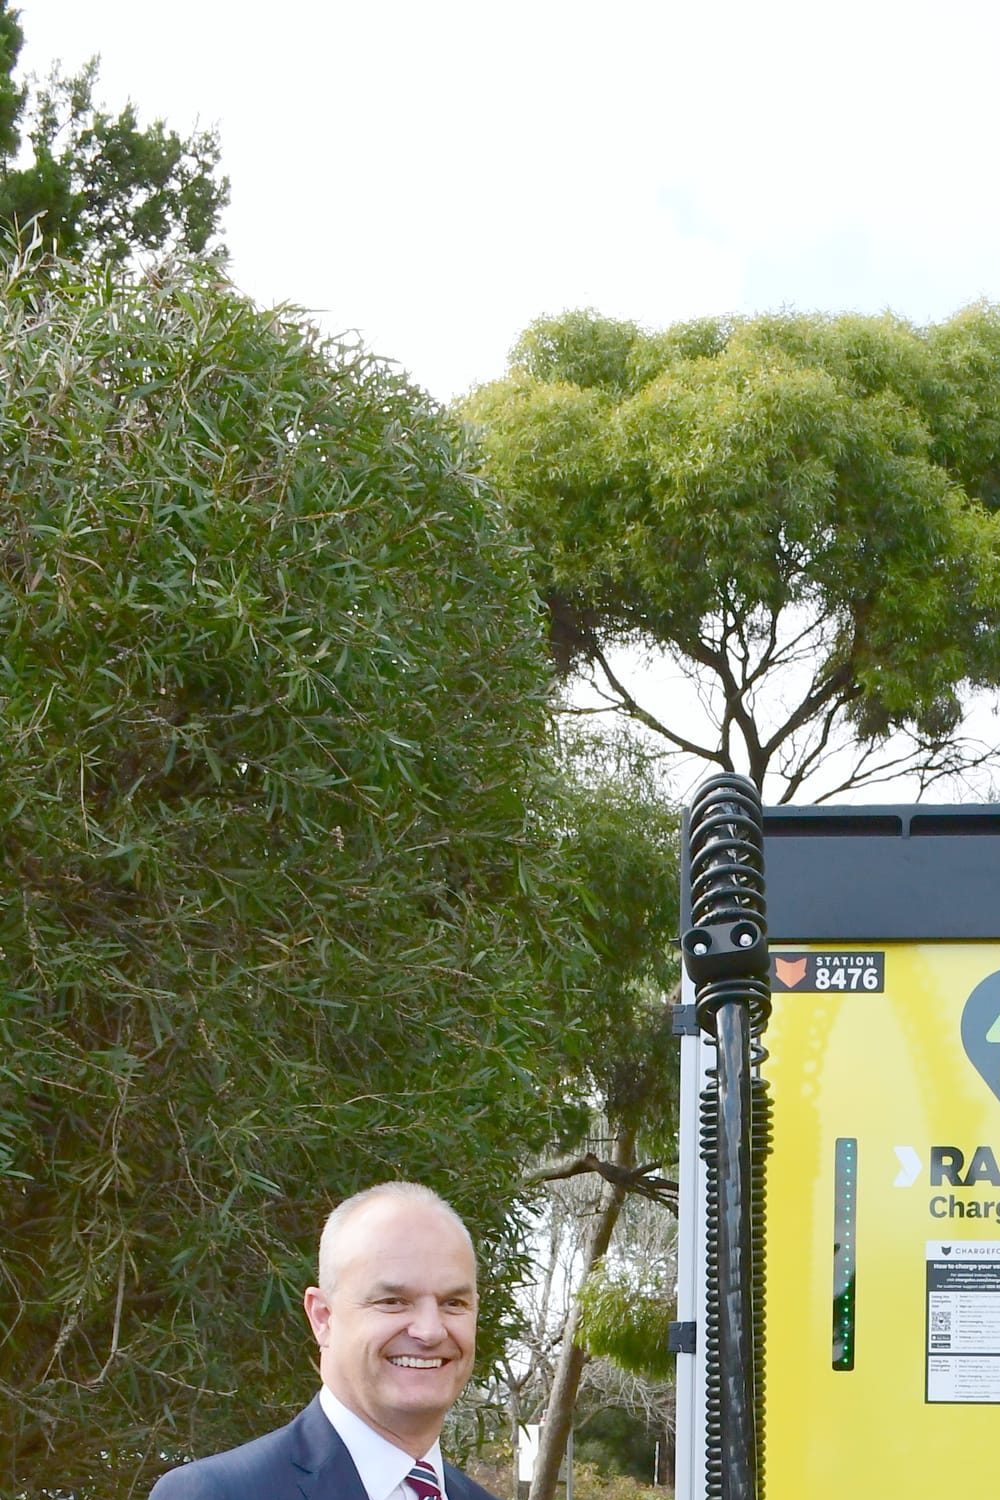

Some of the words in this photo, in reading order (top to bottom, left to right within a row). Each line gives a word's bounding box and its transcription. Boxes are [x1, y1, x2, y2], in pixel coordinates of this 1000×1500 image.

[816, 956, 874, 966] STATION
[815, 968, 878, 990] 8476
[955, 1263, 977, 1271] charge
